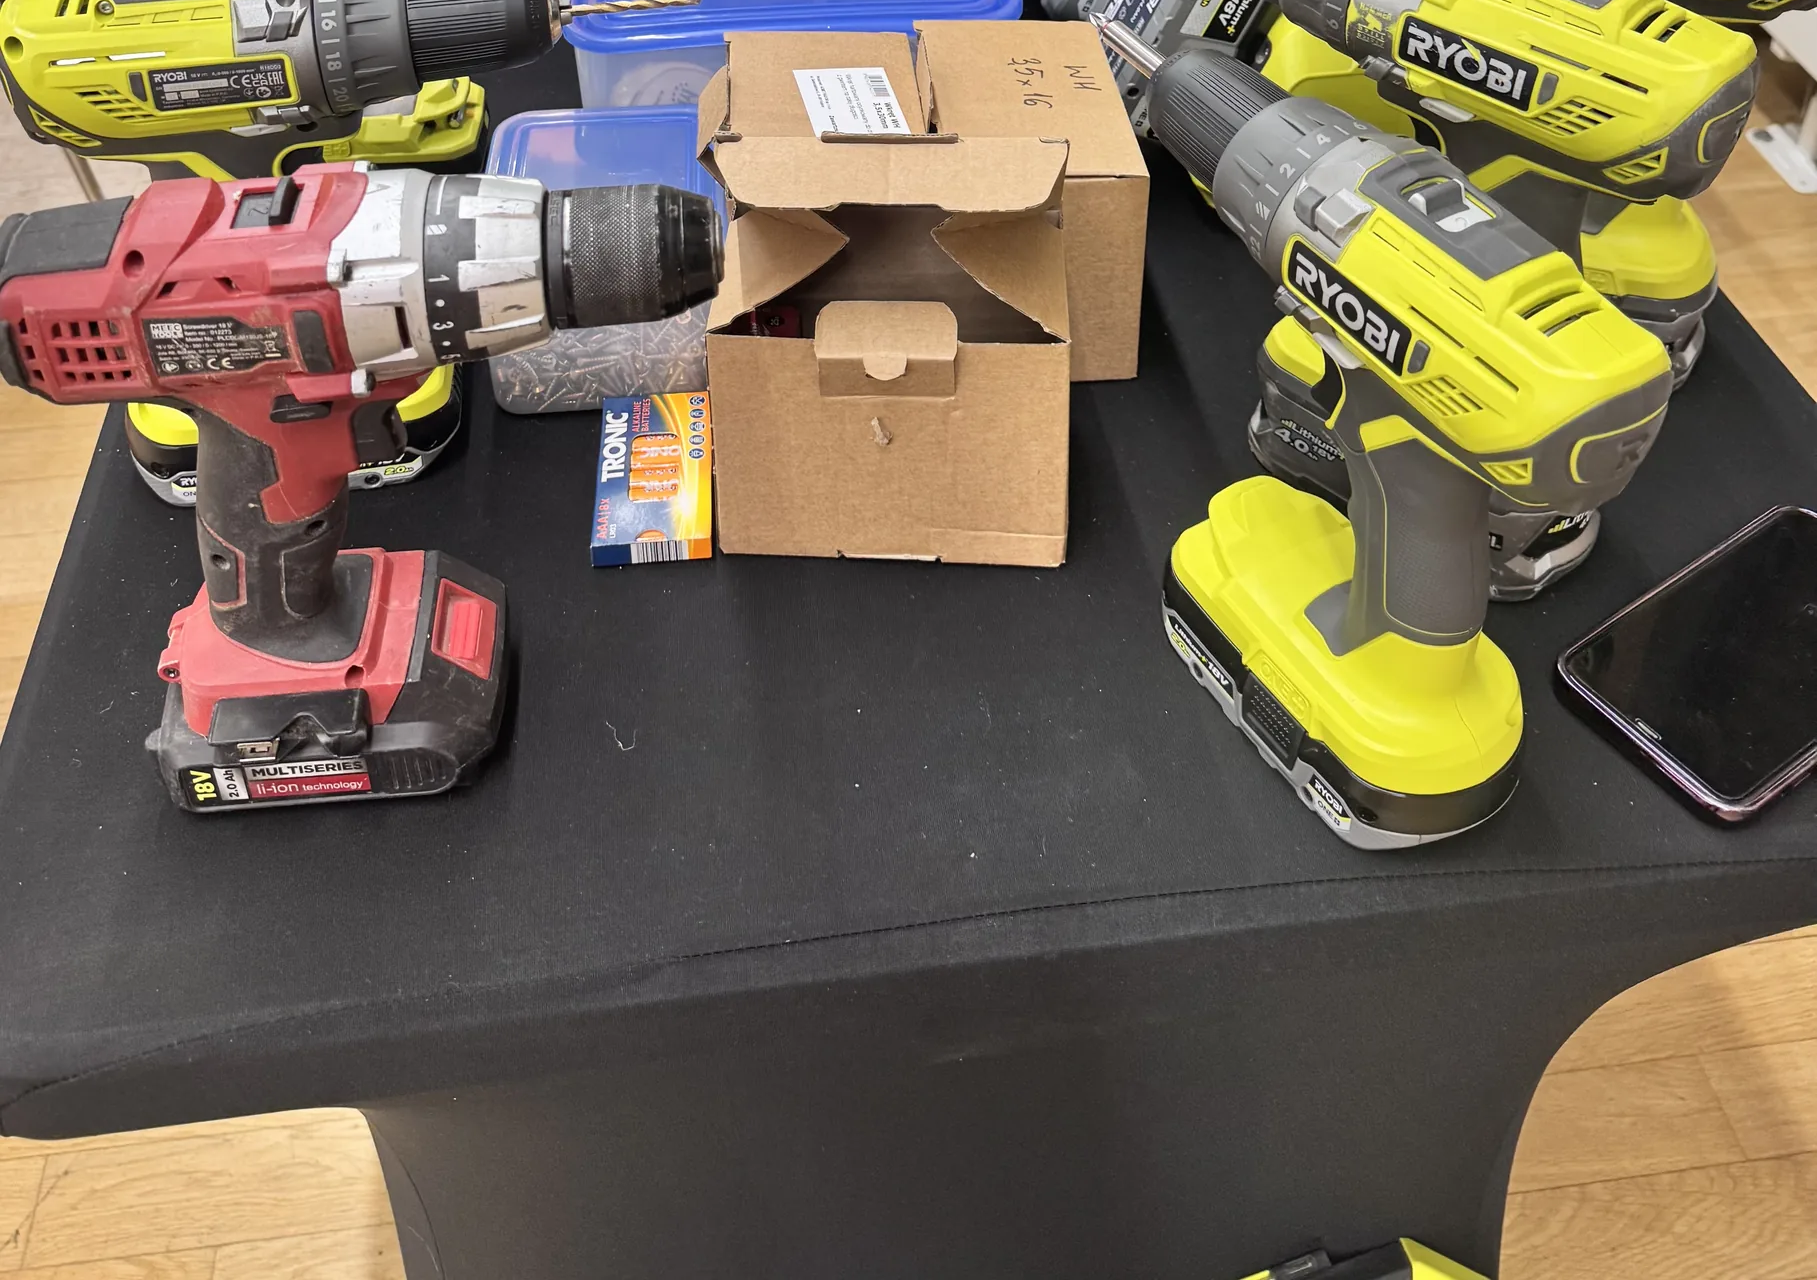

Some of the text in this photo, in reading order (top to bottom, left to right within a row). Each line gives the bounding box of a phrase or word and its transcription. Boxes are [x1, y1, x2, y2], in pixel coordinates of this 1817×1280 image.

[321, 10, 337, 31] 16
[325, 51, 342, 71] 18
[1407, 22, 1530, 102] RYOBI
[153, 71, 187, 83] RYOBI
[333, 87, 349, 102] 20
[1023, 93, 1053, 109] 16
[1279, 162, 1296, 179] 2
[1316, 132, 1332, 146] 4
[427, 274, 450, 285] 1
[1295, 252, 1401, 364] RYOBI
[151, 324, 181, 332] MEEC
[432, 320, 455, 331] 3
[207, 357, 234, 370] CE
[631, 401, 641, 433] ALKALINE
[641, 398, 651, 432] BATTERIES
[601, 412, 629, 483] TRONIC
[1312, 445, 1336, 461] 18V
[609, 523, 617, 538] LR03
[1207, 660, 1230, 686] 18V
[251, 761, 364, 778] MULTISERIES
[190, 770, 217, 801] 18V
[222, 769, 240, 798] 2.0 Ah
[302, 781, 363, 792] technology
[1313, 779, 1343, 814] RYOBI
